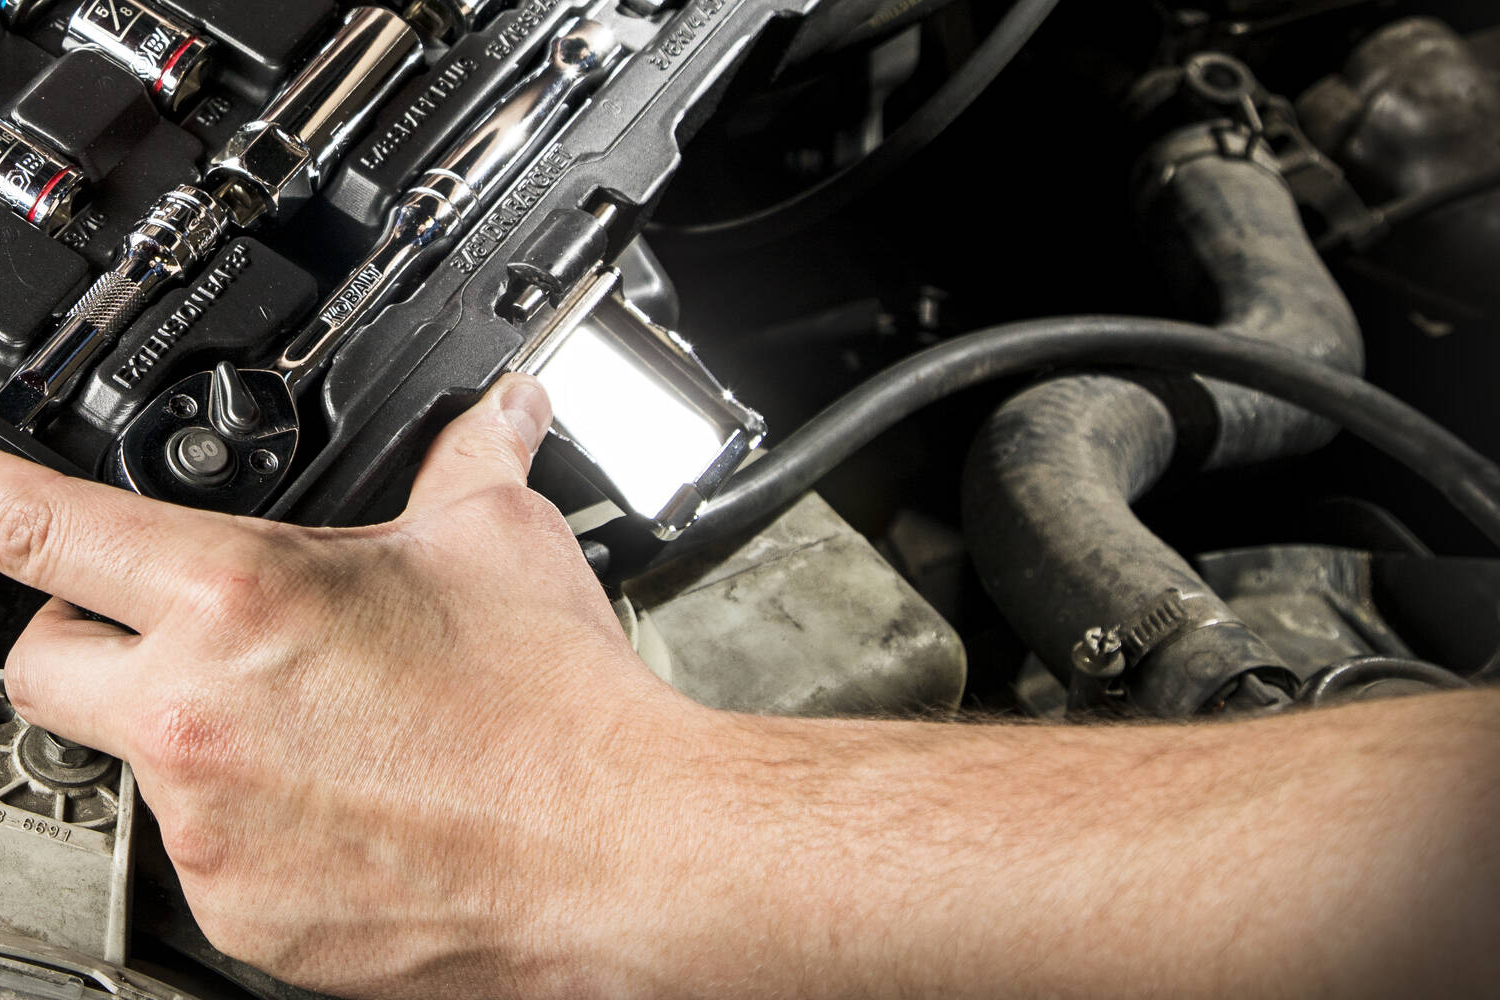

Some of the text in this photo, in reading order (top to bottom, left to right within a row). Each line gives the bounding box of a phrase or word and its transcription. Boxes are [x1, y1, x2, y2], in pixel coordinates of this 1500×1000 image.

[320, 263, 383, 327] KOBALT
[112, 291, 206, 390] EXTENSION
[187, 439, 219, 462] 90
